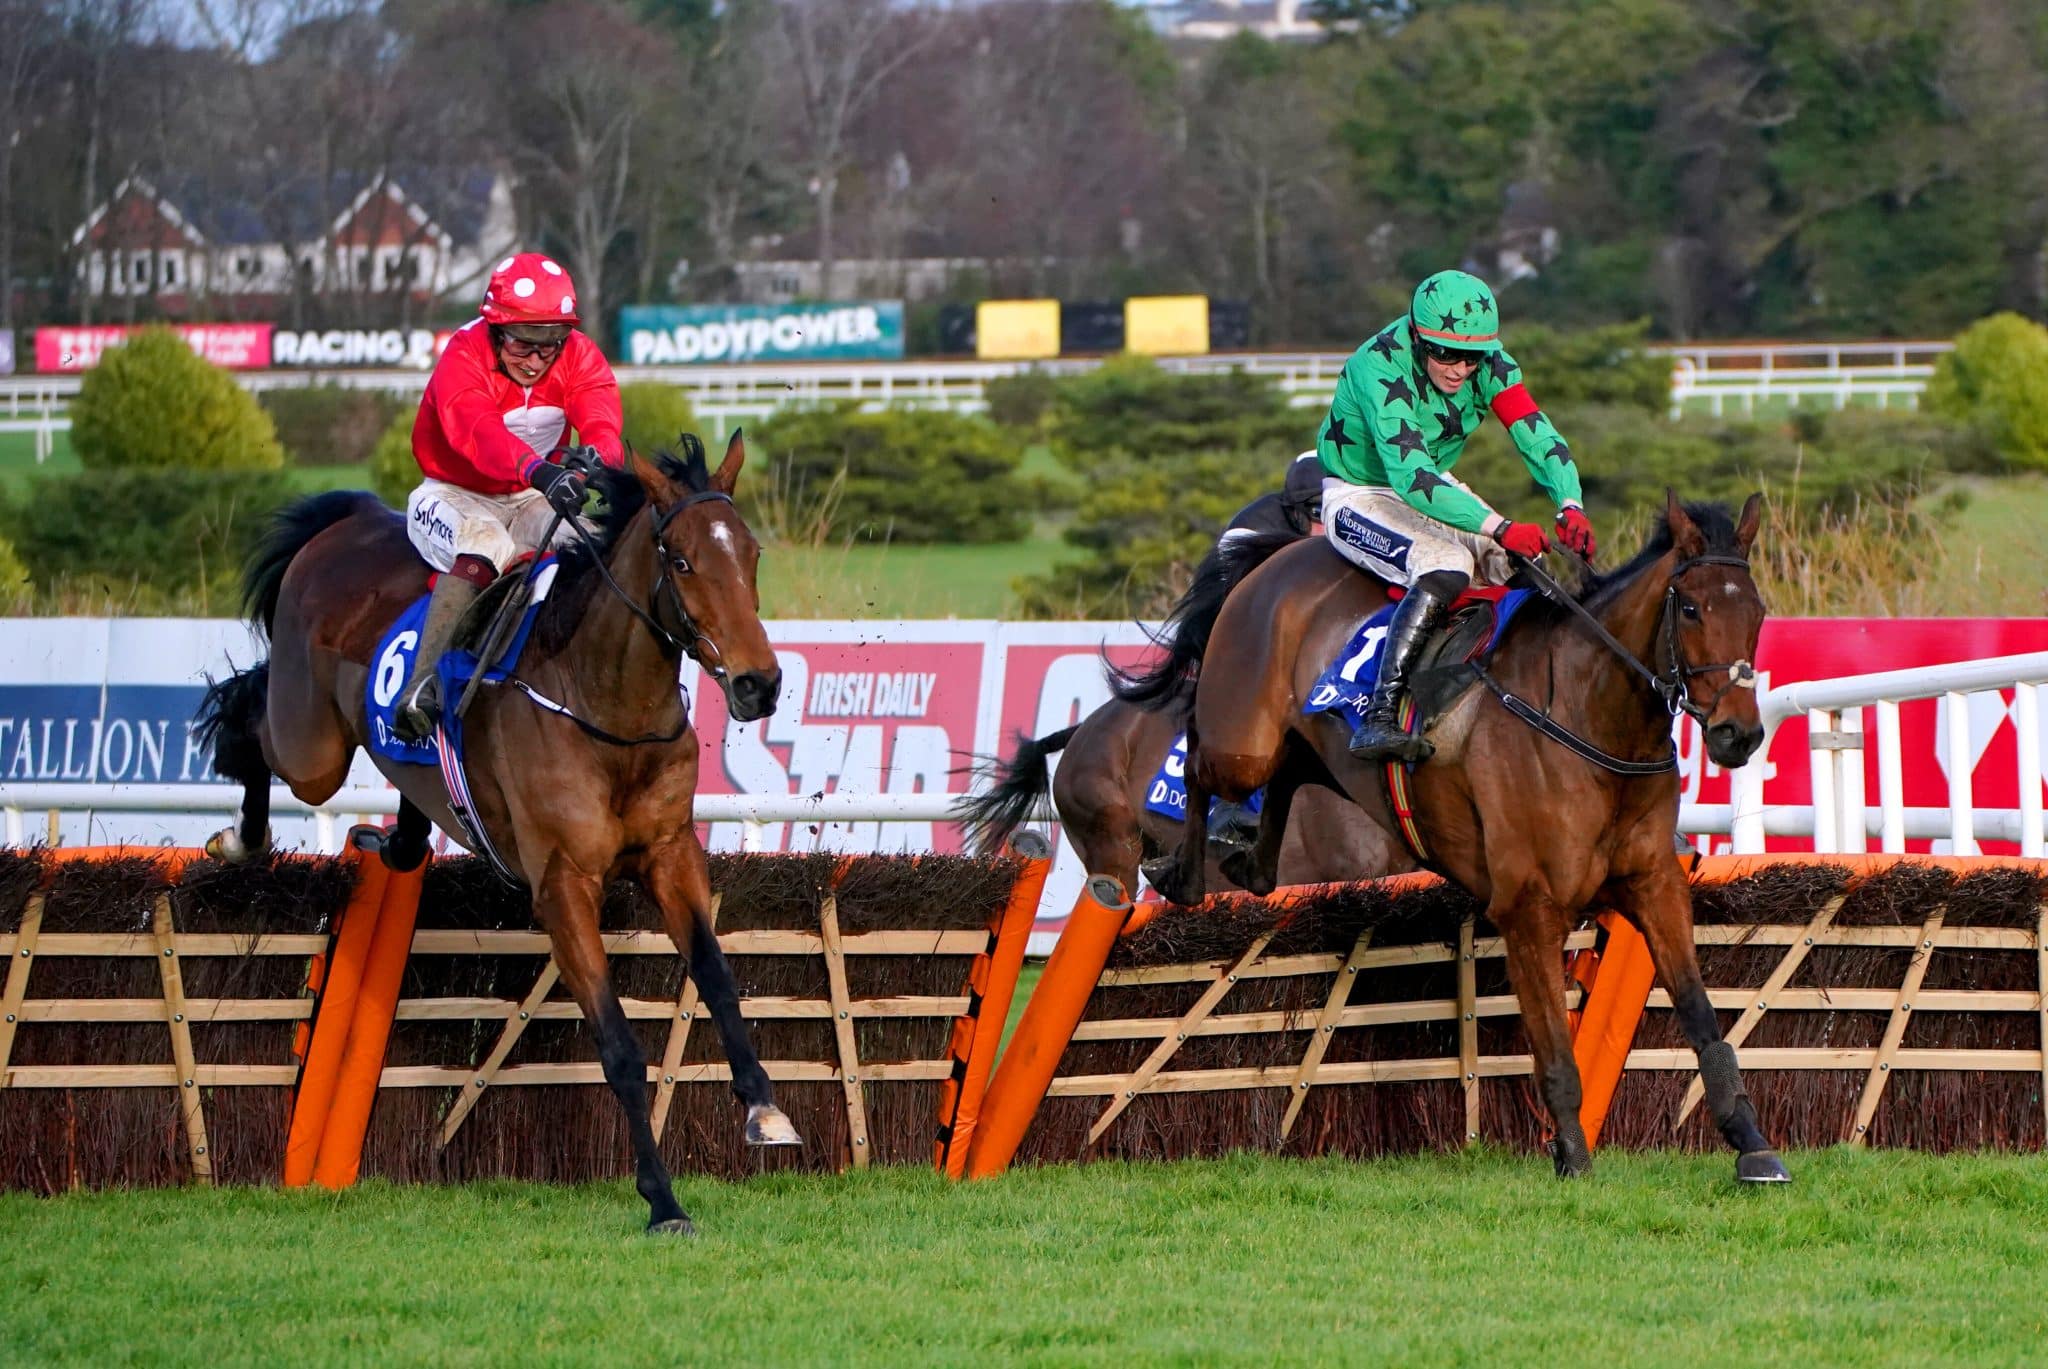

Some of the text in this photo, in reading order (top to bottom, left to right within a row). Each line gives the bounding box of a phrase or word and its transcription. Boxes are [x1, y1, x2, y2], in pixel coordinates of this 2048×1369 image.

[272, 329, 404, 365] RACING
[631, 306, 882, 365] PADDYPOWER
[1337, 511, 1392, 549] UNDERWRITING
[374, 630, 418, 707] 6
[807, 673, 936, 717] IRISH DAILY
[705, 650, 952, 854] STAR
